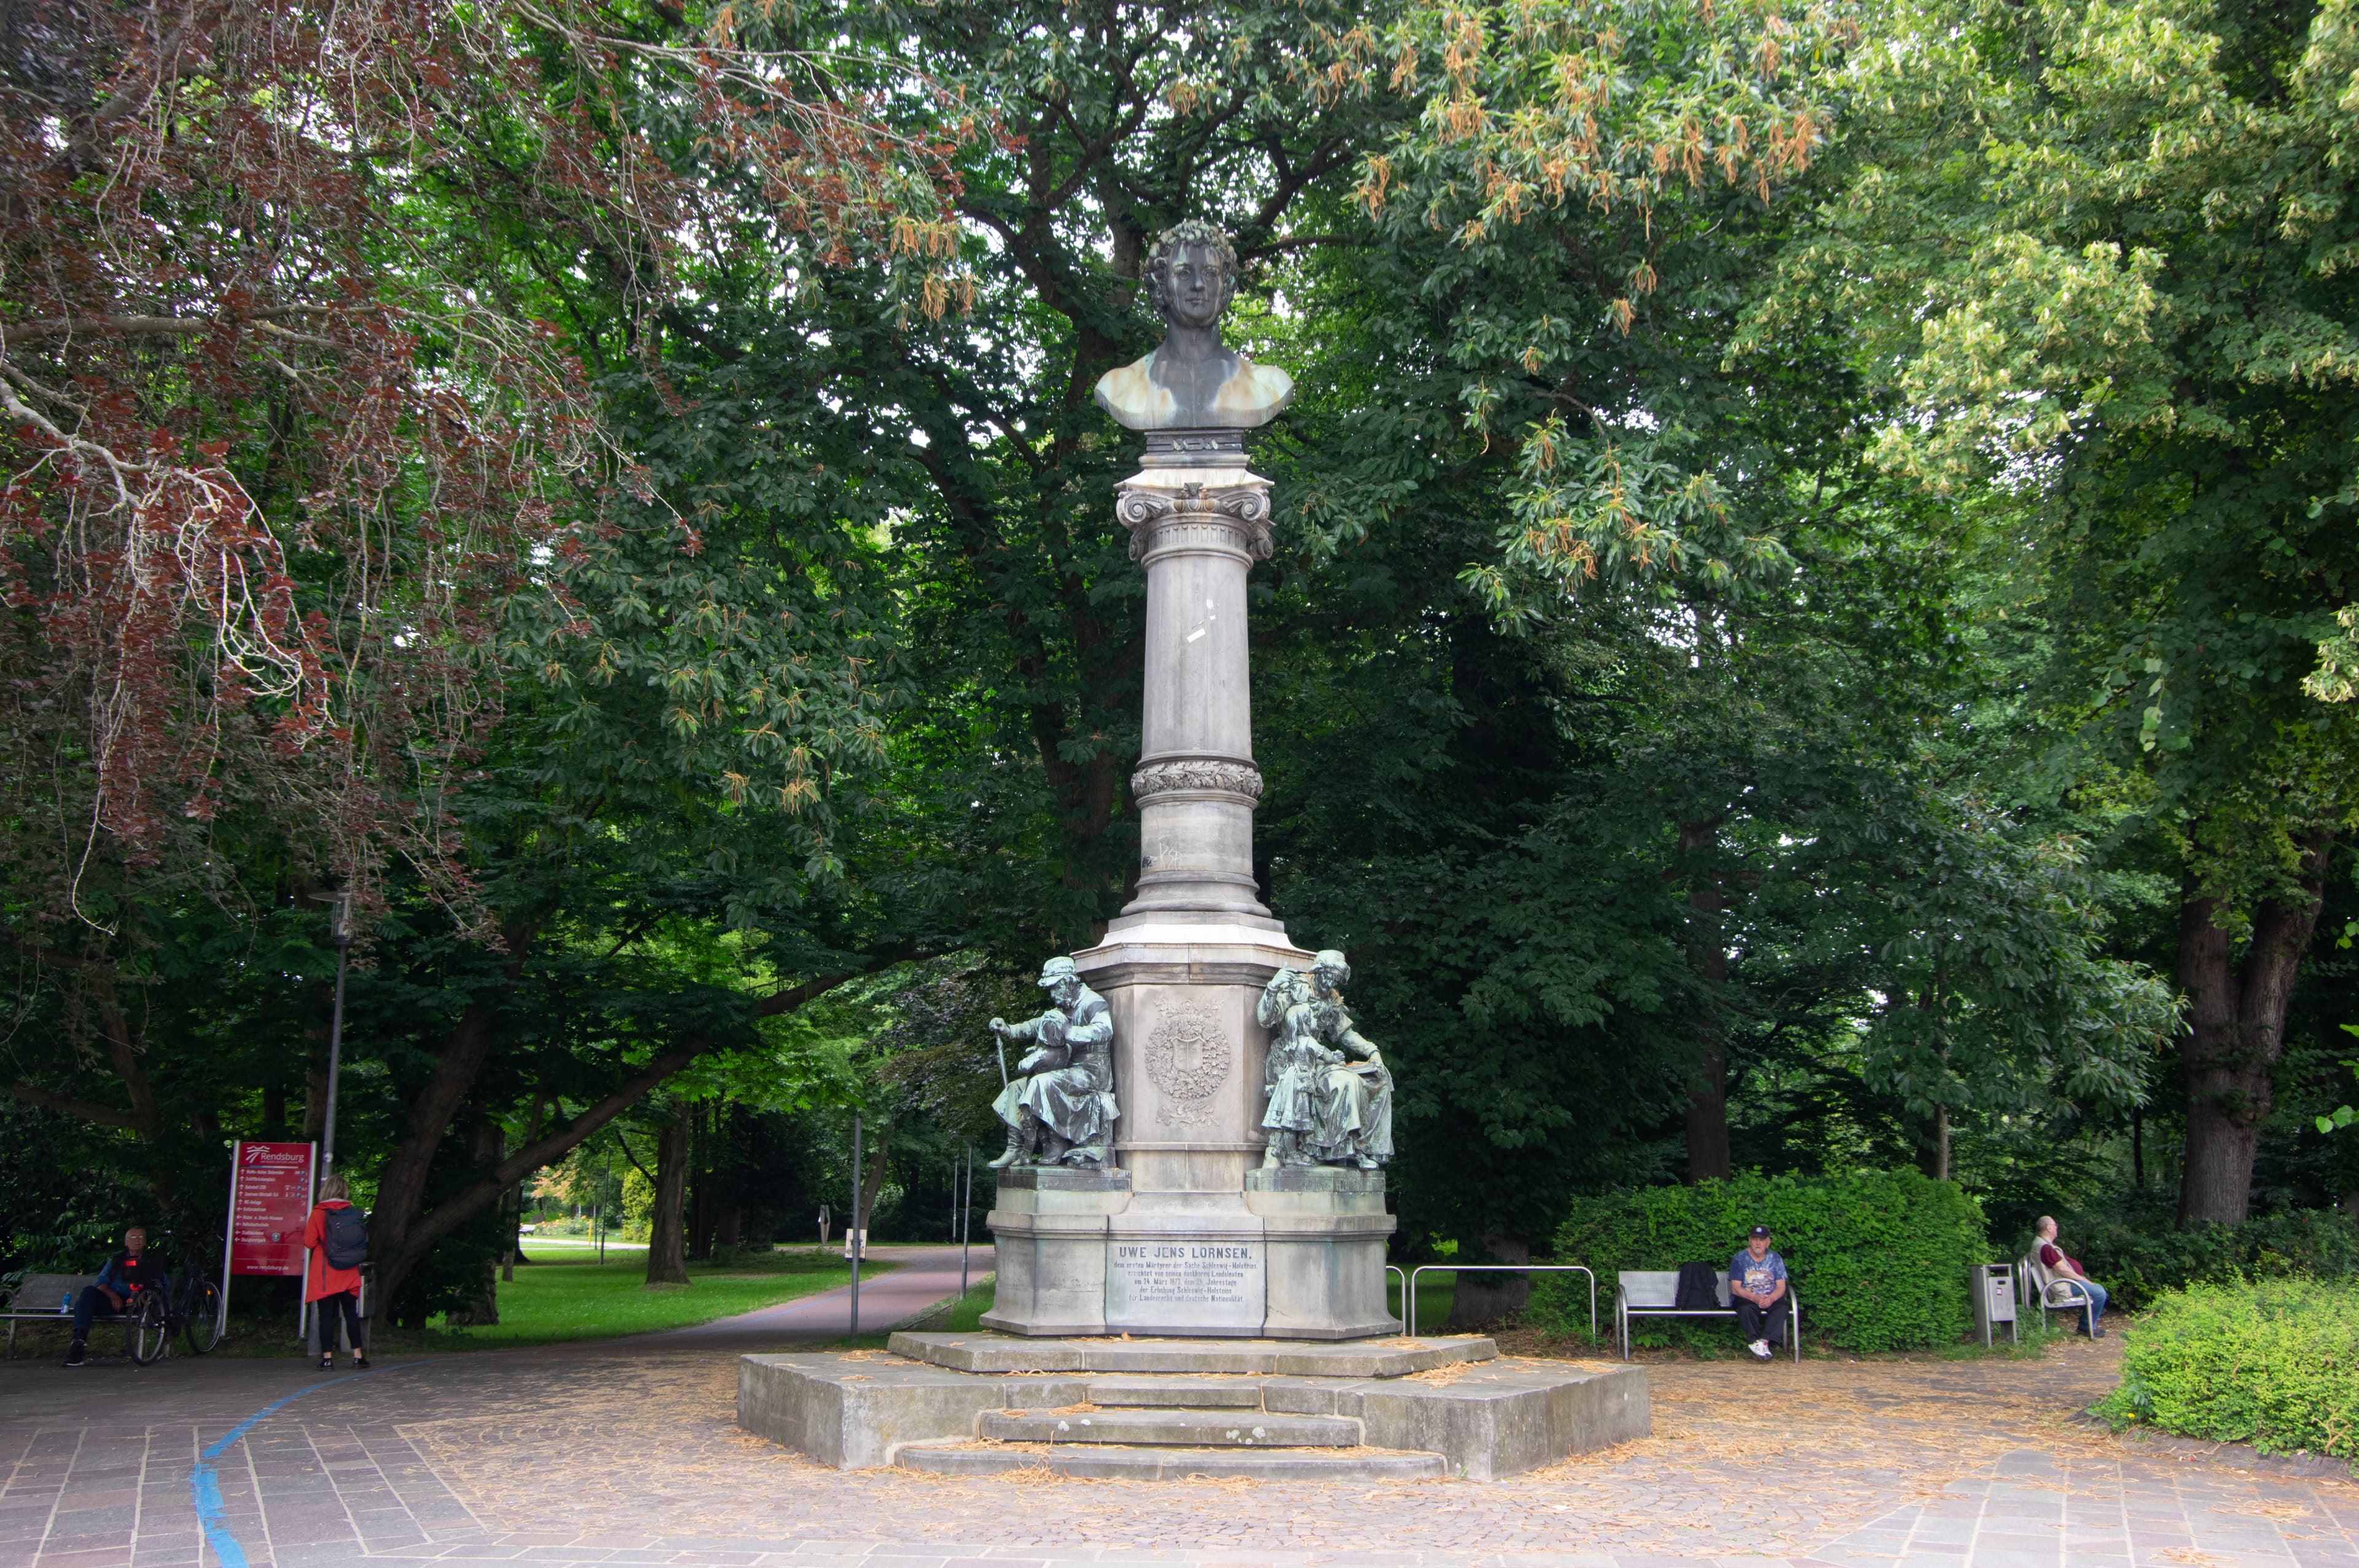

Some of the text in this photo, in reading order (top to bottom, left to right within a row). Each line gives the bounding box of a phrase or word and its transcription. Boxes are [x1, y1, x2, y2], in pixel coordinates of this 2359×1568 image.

[260, 1152, 304, 1163] Rendsburg
[1119, 1247, 1252, 1260] UWE JENS LORNSEN.
[1146, 1261, 1172, 1270] Märtyrer
[1207, 1279, 1237, 1288] Jahrestage
[1151, 1286, 1175, 1295] Erhebung
[1177, 1286, 1232, 1295] Schleswig-Holsteins
